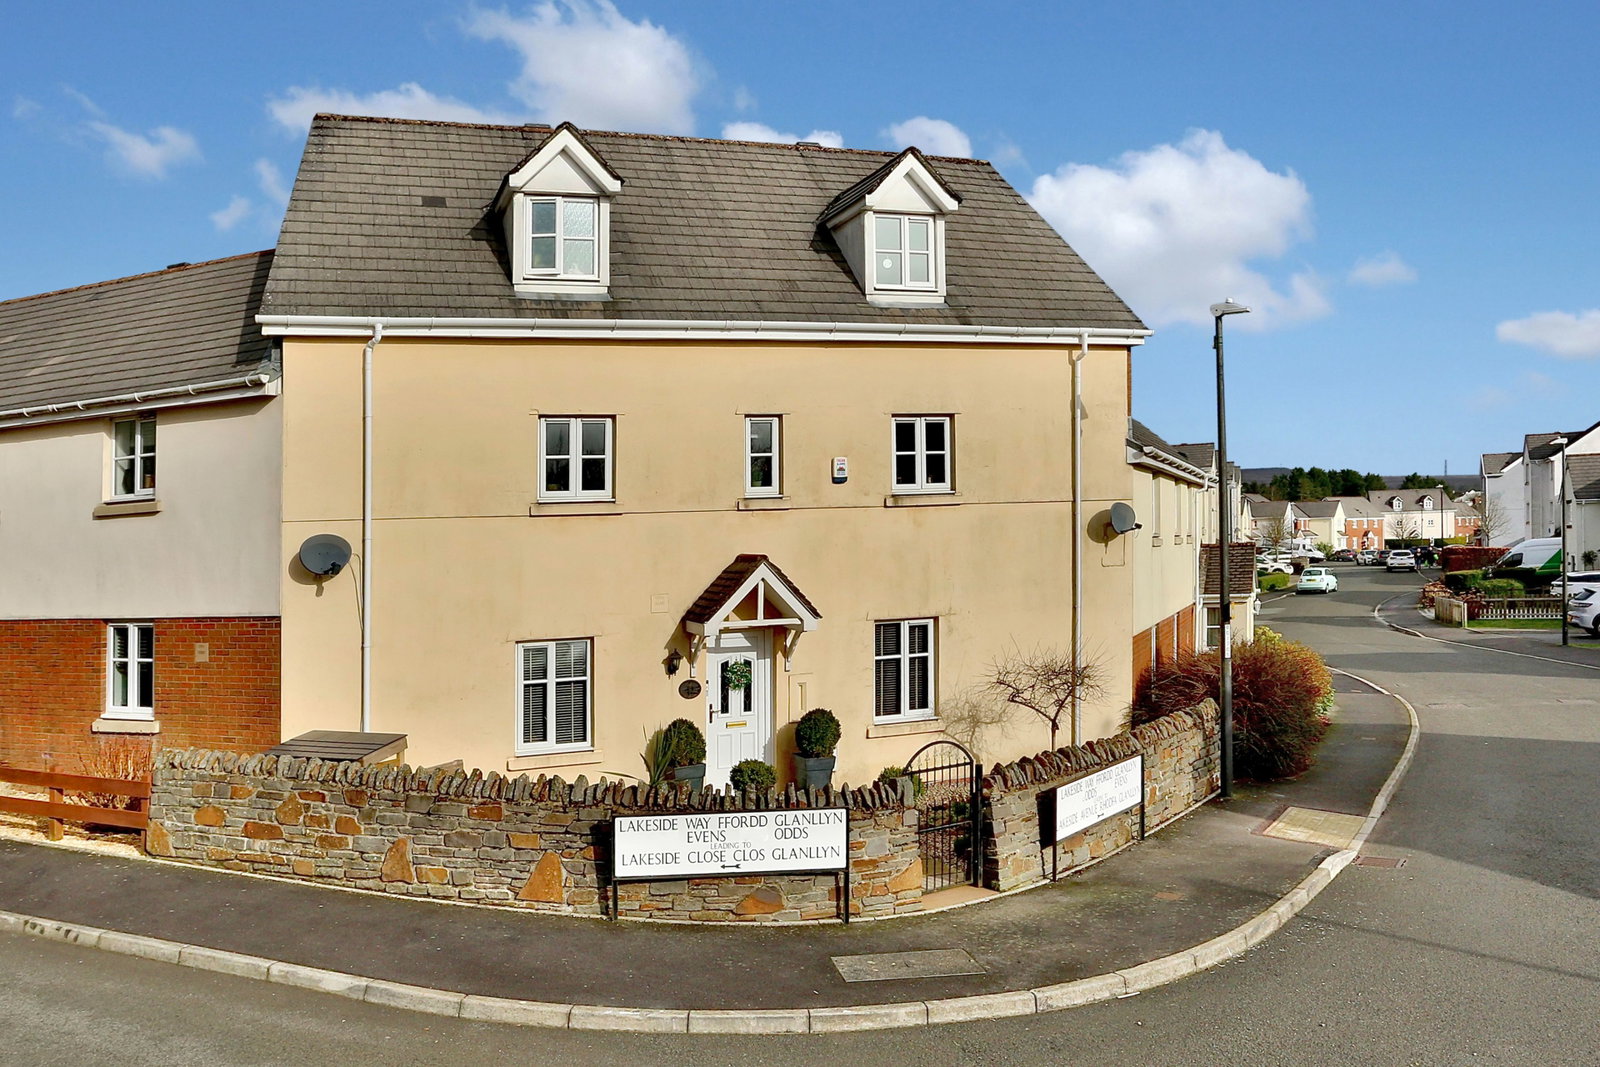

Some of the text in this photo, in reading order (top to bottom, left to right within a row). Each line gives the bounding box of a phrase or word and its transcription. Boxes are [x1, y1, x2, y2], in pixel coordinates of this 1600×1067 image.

[1060, 781, 1083, 800] LAKESIDE
[619, 812, 843, 832] LAKESIDE WAY FFORDD GLANLLYN
[1057, 812, 1078, 831] AKESIDE
[687, 826, 809, 843] EVENS ODDS
[622, 845, 840, 866] LAKESIDE CLOSE CLOS GLANLLYN
[710, 842, 740, 850] LEADING
